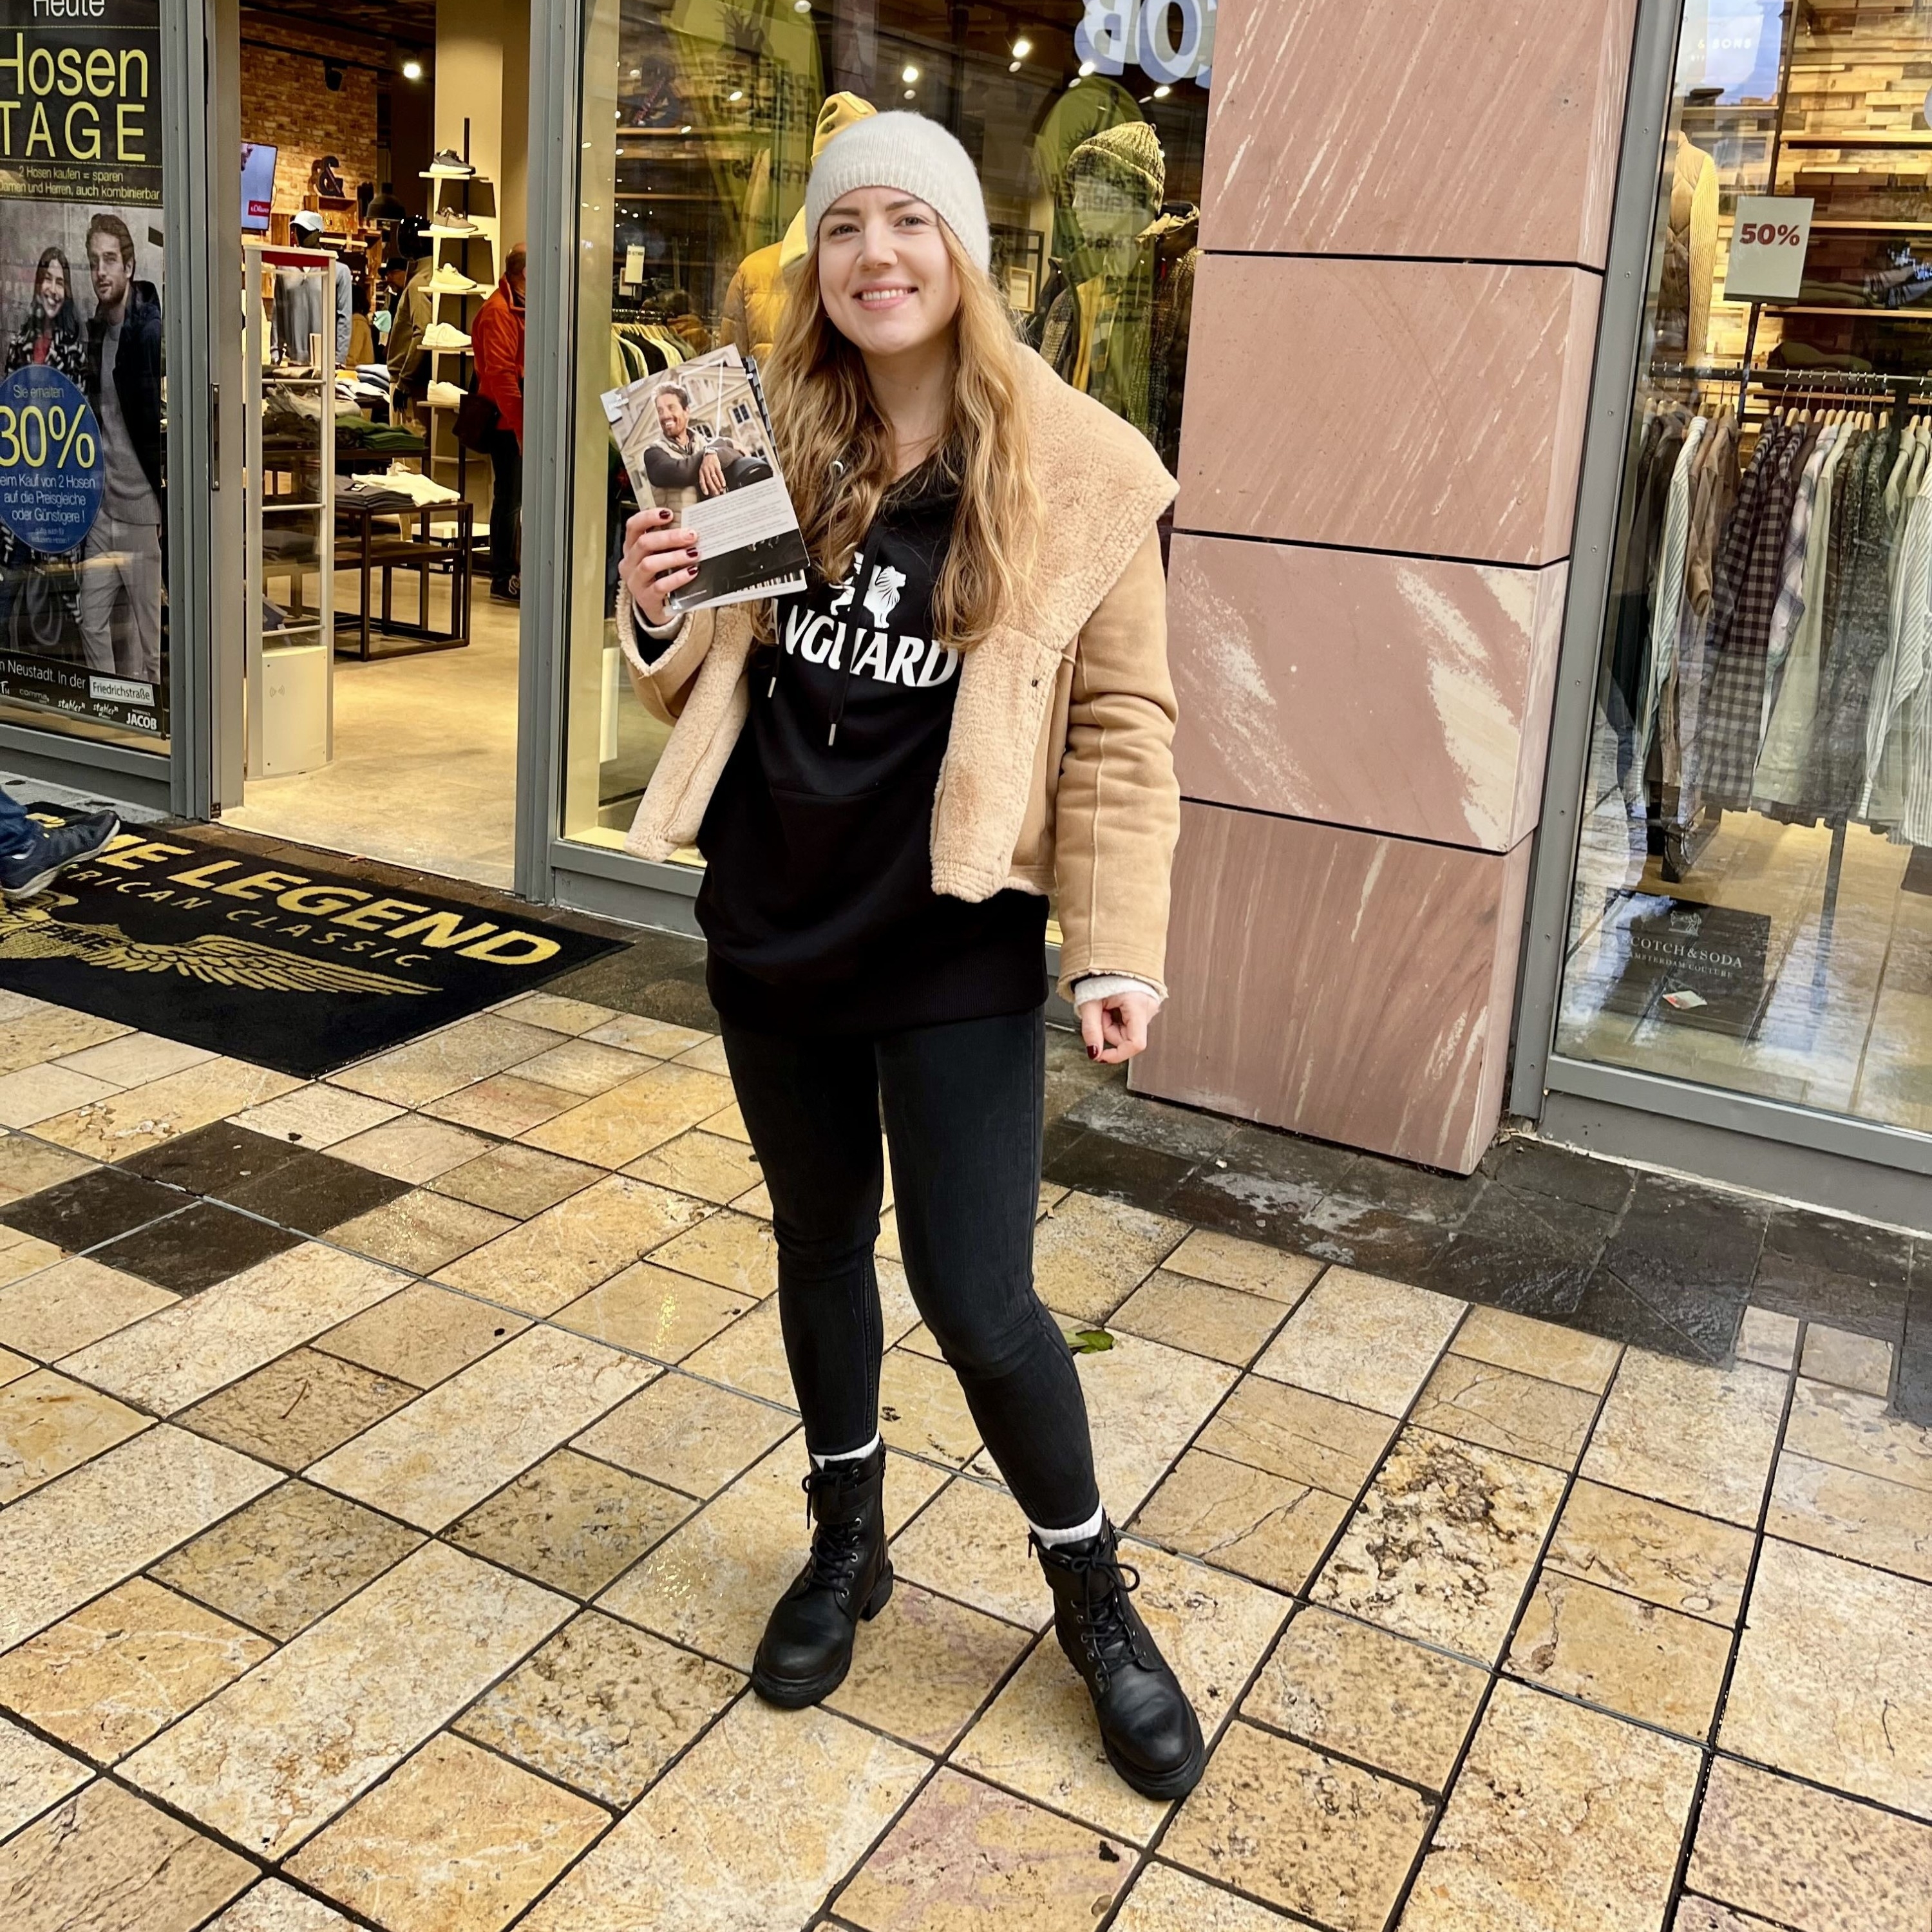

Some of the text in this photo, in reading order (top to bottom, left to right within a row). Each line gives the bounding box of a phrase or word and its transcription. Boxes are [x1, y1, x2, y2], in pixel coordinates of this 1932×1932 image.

[0, 32, 147, 97] Hosen
[0, 101, 146, 161] TAGE
[19, 166, 24, 177] 2
[26, 167, 52, 179] Hosen
[53, 167, 80, 180] kaufen
[92, 171, 124, 183] sparen
[28, 182, 43, 193] und
[76, 184, 99, 196] auch
[101, 185, 160, 200] kombinierbar
[1739, 223, 1800, 246] 50%
[0, 404, 95, 469] 30%
[0, 473, 96, 489] eim Kauf von 2 Hosen
[4, 489, 18, 503] auf
[21, 490, 34, 504] die
[12, 507, 32, 521] oder
[58, 670, 67, 685] In
[70, 674, 86, 689] der
[93, 681, 151, 701] Friedrichstraße
[126, 712, 157, 730] JACOB
[64, 864, 431, 967] RICAN CLASSIC
[166, 859, 562, 965] LEGEND
